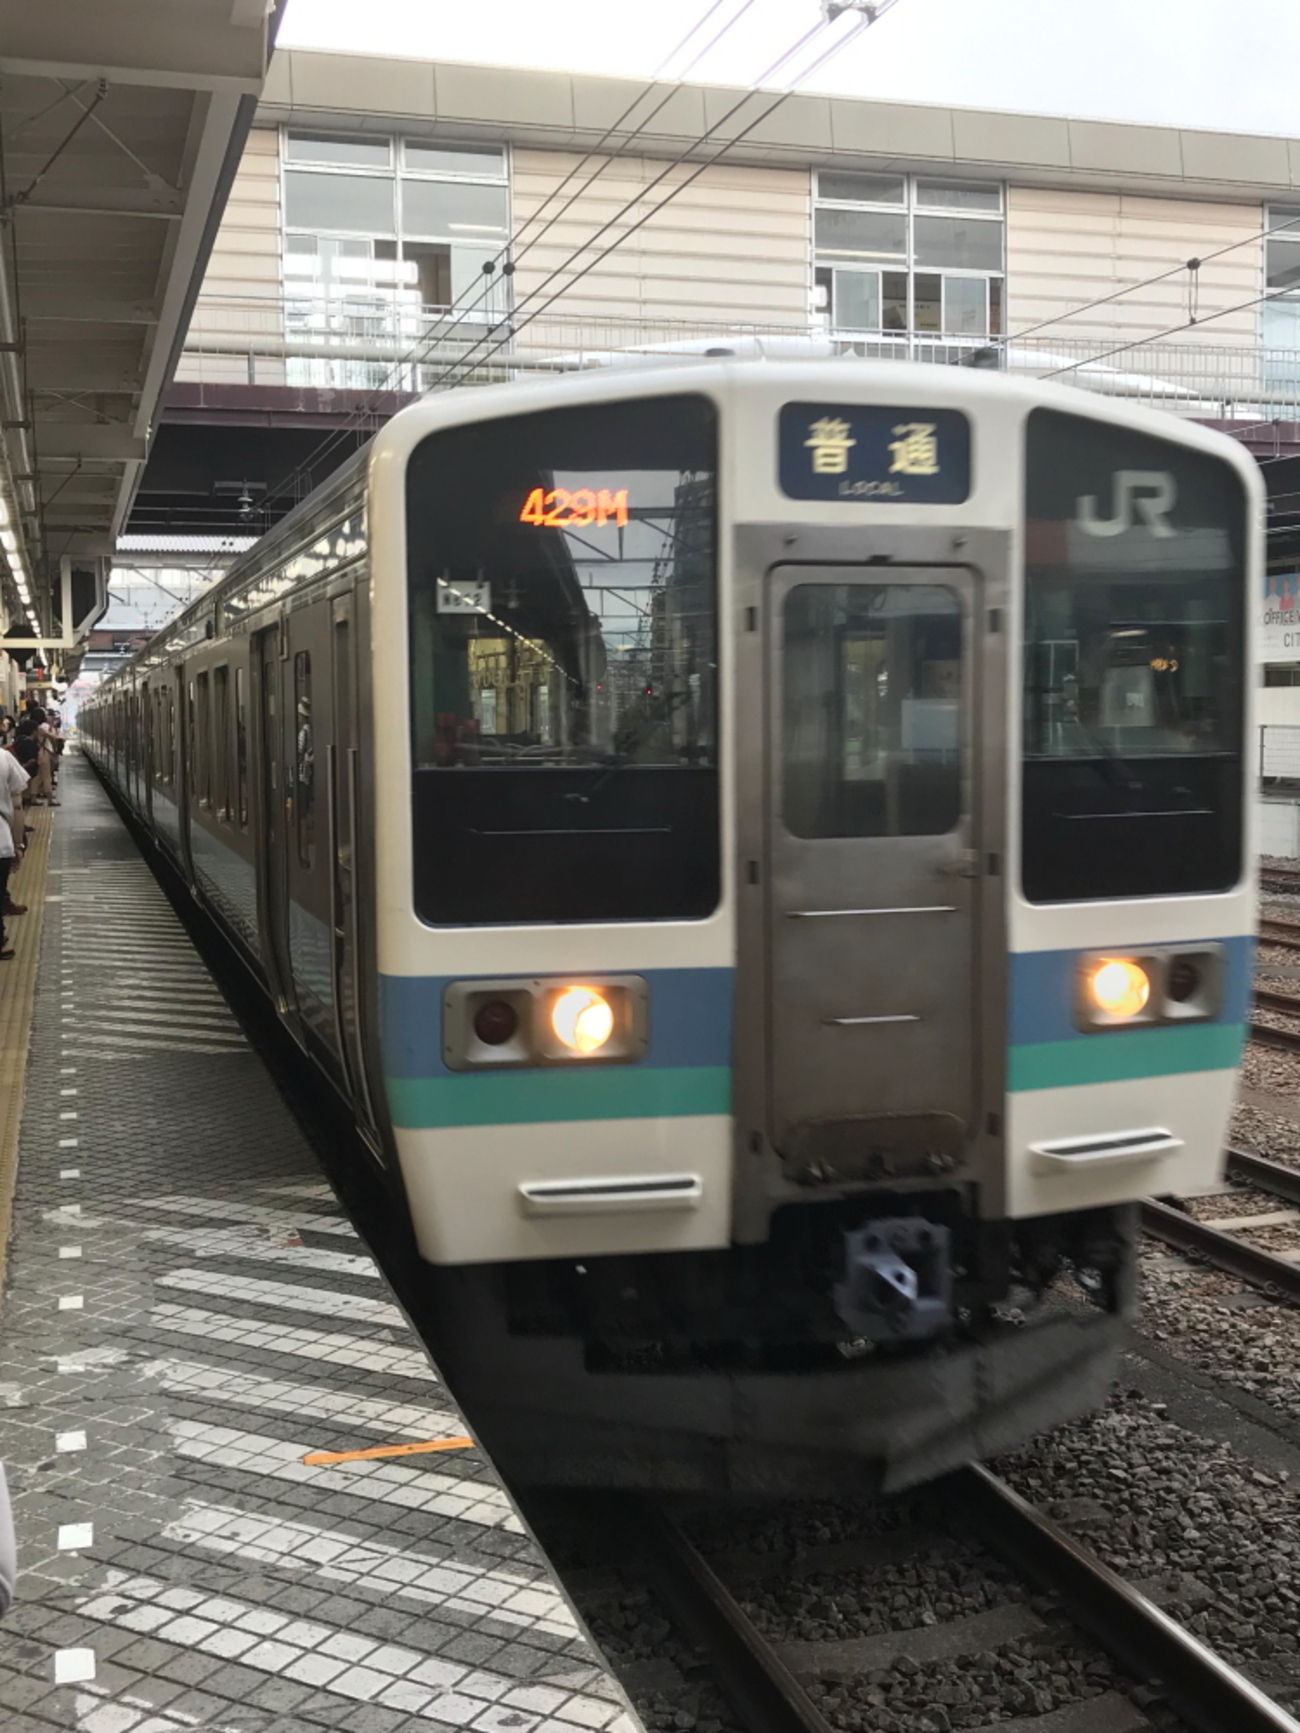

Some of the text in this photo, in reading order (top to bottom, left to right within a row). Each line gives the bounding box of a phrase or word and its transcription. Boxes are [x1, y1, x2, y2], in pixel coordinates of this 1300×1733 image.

[804, 417, 940, 475] 普通
[520, 487, 628, 527] 429M
[1076, 469, 1177, 537] JR
